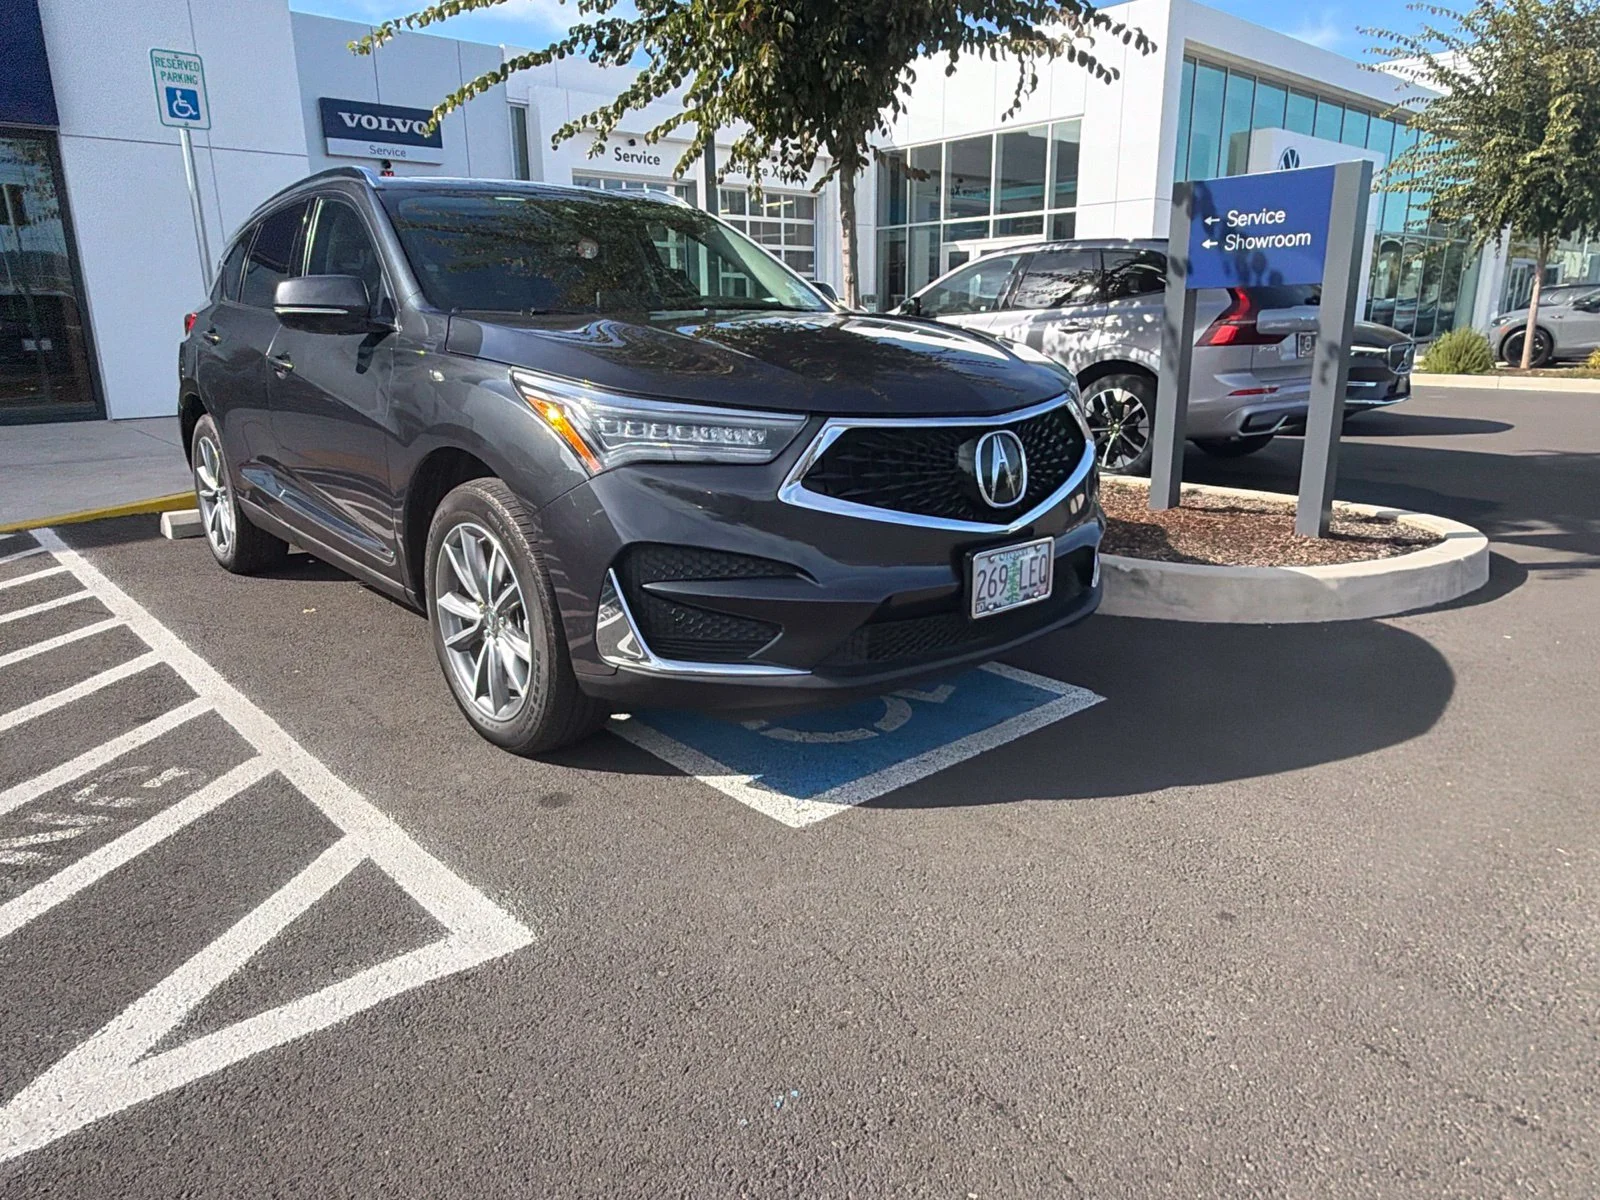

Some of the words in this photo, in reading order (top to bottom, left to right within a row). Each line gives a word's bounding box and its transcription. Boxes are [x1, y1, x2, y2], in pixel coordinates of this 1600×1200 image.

[154, 56, 200, 73] RESERVED
[160, 70, 198, 85] PARKING
[338, 111, 430, 135] VOLVO
[369, 144, 407, 158] Service
[614, 147, 660, 165] Service
[1226, 207, 1286, 228] Service
[1224, 232, 1312, 252] Showroom
[976, 564, 1008, 602] 269
